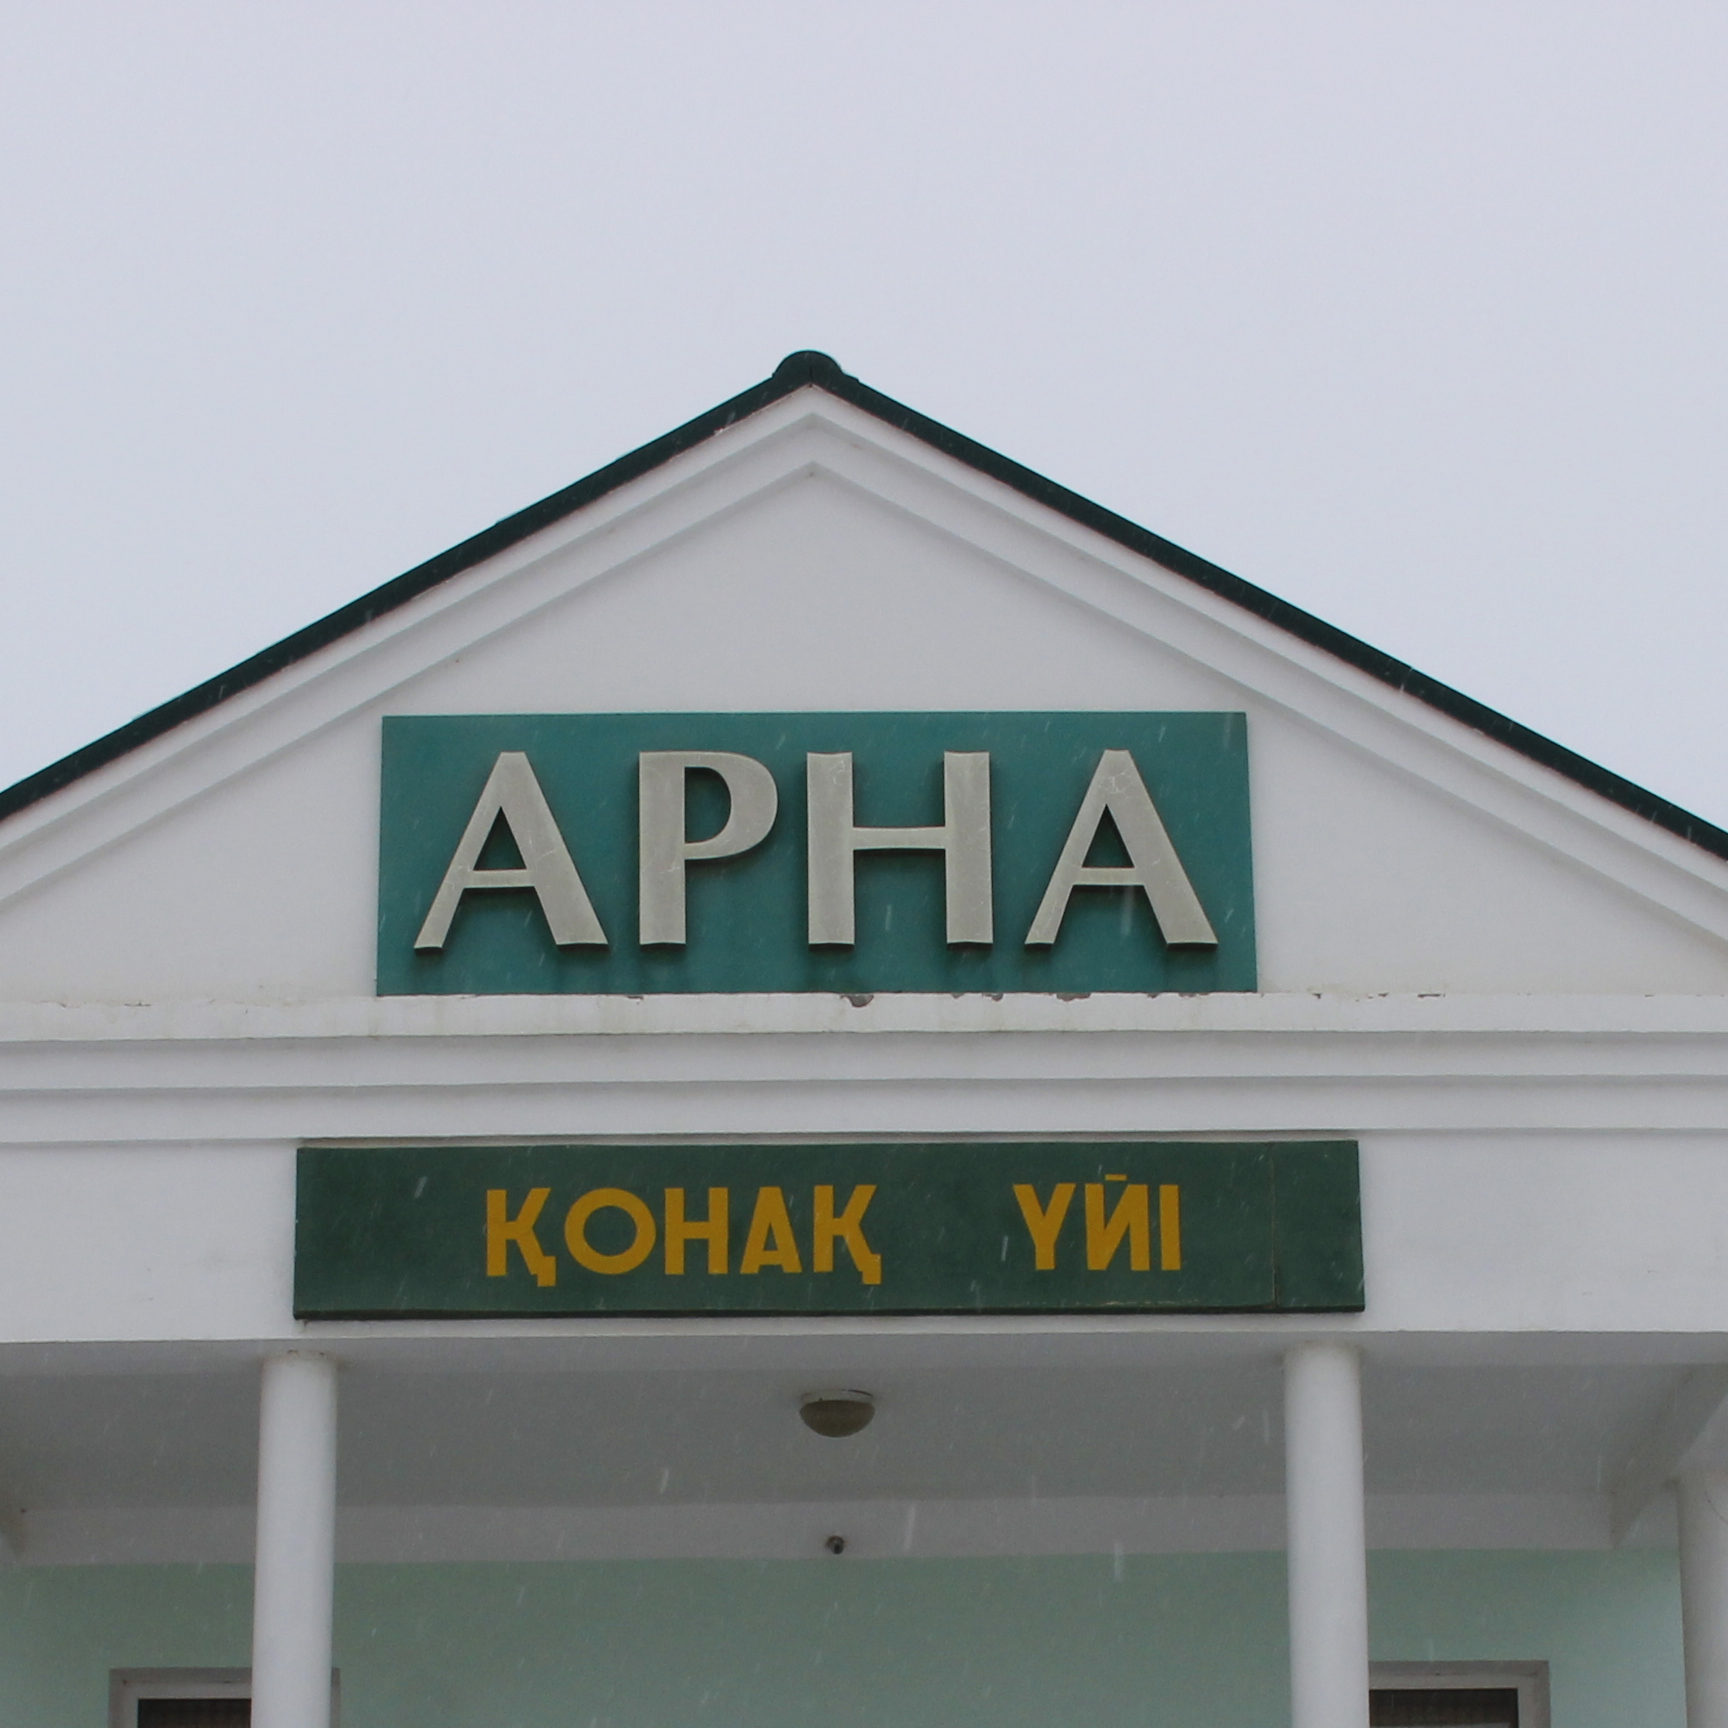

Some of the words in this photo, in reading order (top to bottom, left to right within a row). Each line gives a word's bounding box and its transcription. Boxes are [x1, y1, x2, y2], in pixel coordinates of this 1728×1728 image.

[414, 750, 1217, 950] АРНА
[485, 1184, 882, 1287] ҚОНАҚ
[1013, 1174, 1182, 1271] ҮЙІ
